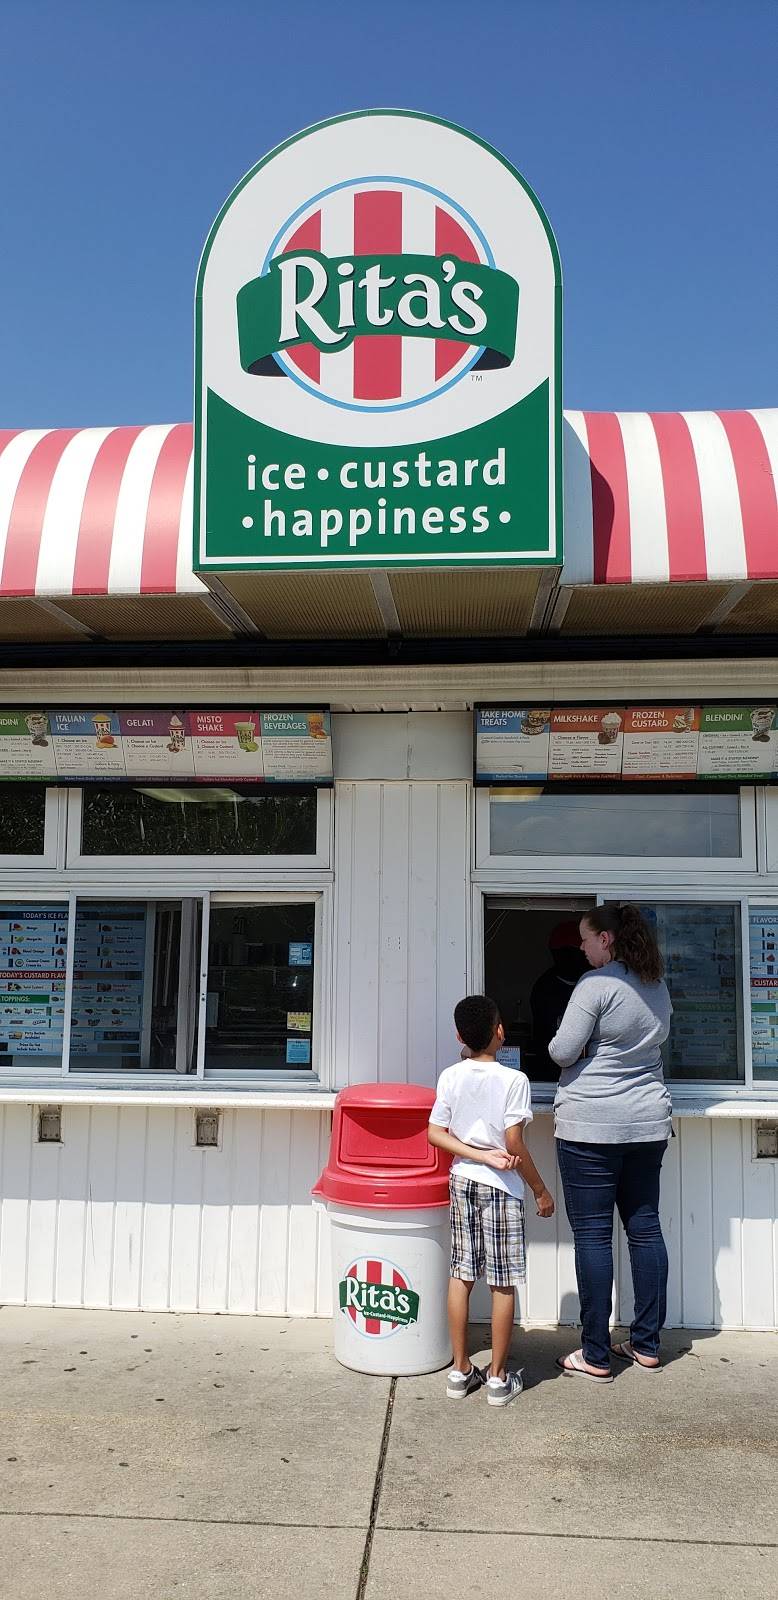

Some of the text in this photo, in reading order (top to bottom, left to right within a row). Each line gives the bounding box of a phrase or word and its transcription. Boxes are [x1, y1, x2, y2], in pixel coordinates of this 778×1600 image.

[278, 256, 488, 344] Rita's
[247, 447, 506, 491] ice custard
[264, 498, 490, 547] happiness
[55, 715, 86, 723] ITALIAN
[263, 713, 293, 721] FROZEN
[632, 711, 665, 719] FROZEN
[705, 713, 743, 721] BLENDINI
[126, 719, 154, 727] GELATI
[264, 722, 306, 730] BEVERAGES
[481, 718, 507, 726] TREATS
[631, 719, 669, 727] CUSTARD
[346, 1276, 410, 1313] Rita's
